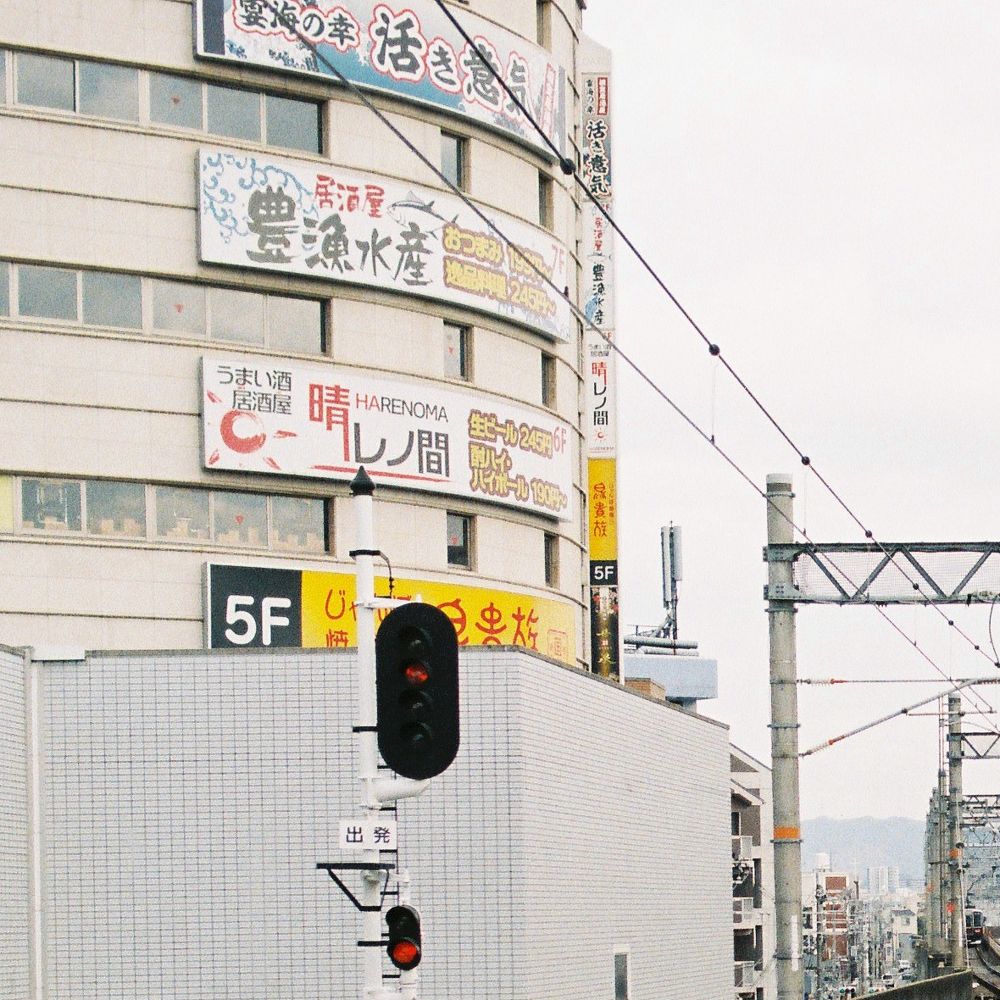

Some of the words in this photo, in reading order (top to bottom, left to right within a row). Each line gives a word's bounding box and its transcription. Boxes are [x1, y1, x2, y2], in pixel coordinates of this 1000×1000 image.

[375, 12, 529, 118] 活き意気
[588, 121, 607, 195] 活き意気
[315, 174, 385, 218] 居酒屋
[246, 185, 433, 286] 豊漁水産
[217, 366, 292, 390] うまい酒
[591, 362, 608, 426] 晴レノ間
[233, 391, 292, 415] 居酒屋
[355, 393, 449, 422] HARENOMA
[469, 409, 518, 447] 生ビール
[520, 423, 553, 459] 245円
[594, 566, 615, 581] 5F
[226, 596, 292, 645] 5F
[346, 826, 391, 843] 出発
